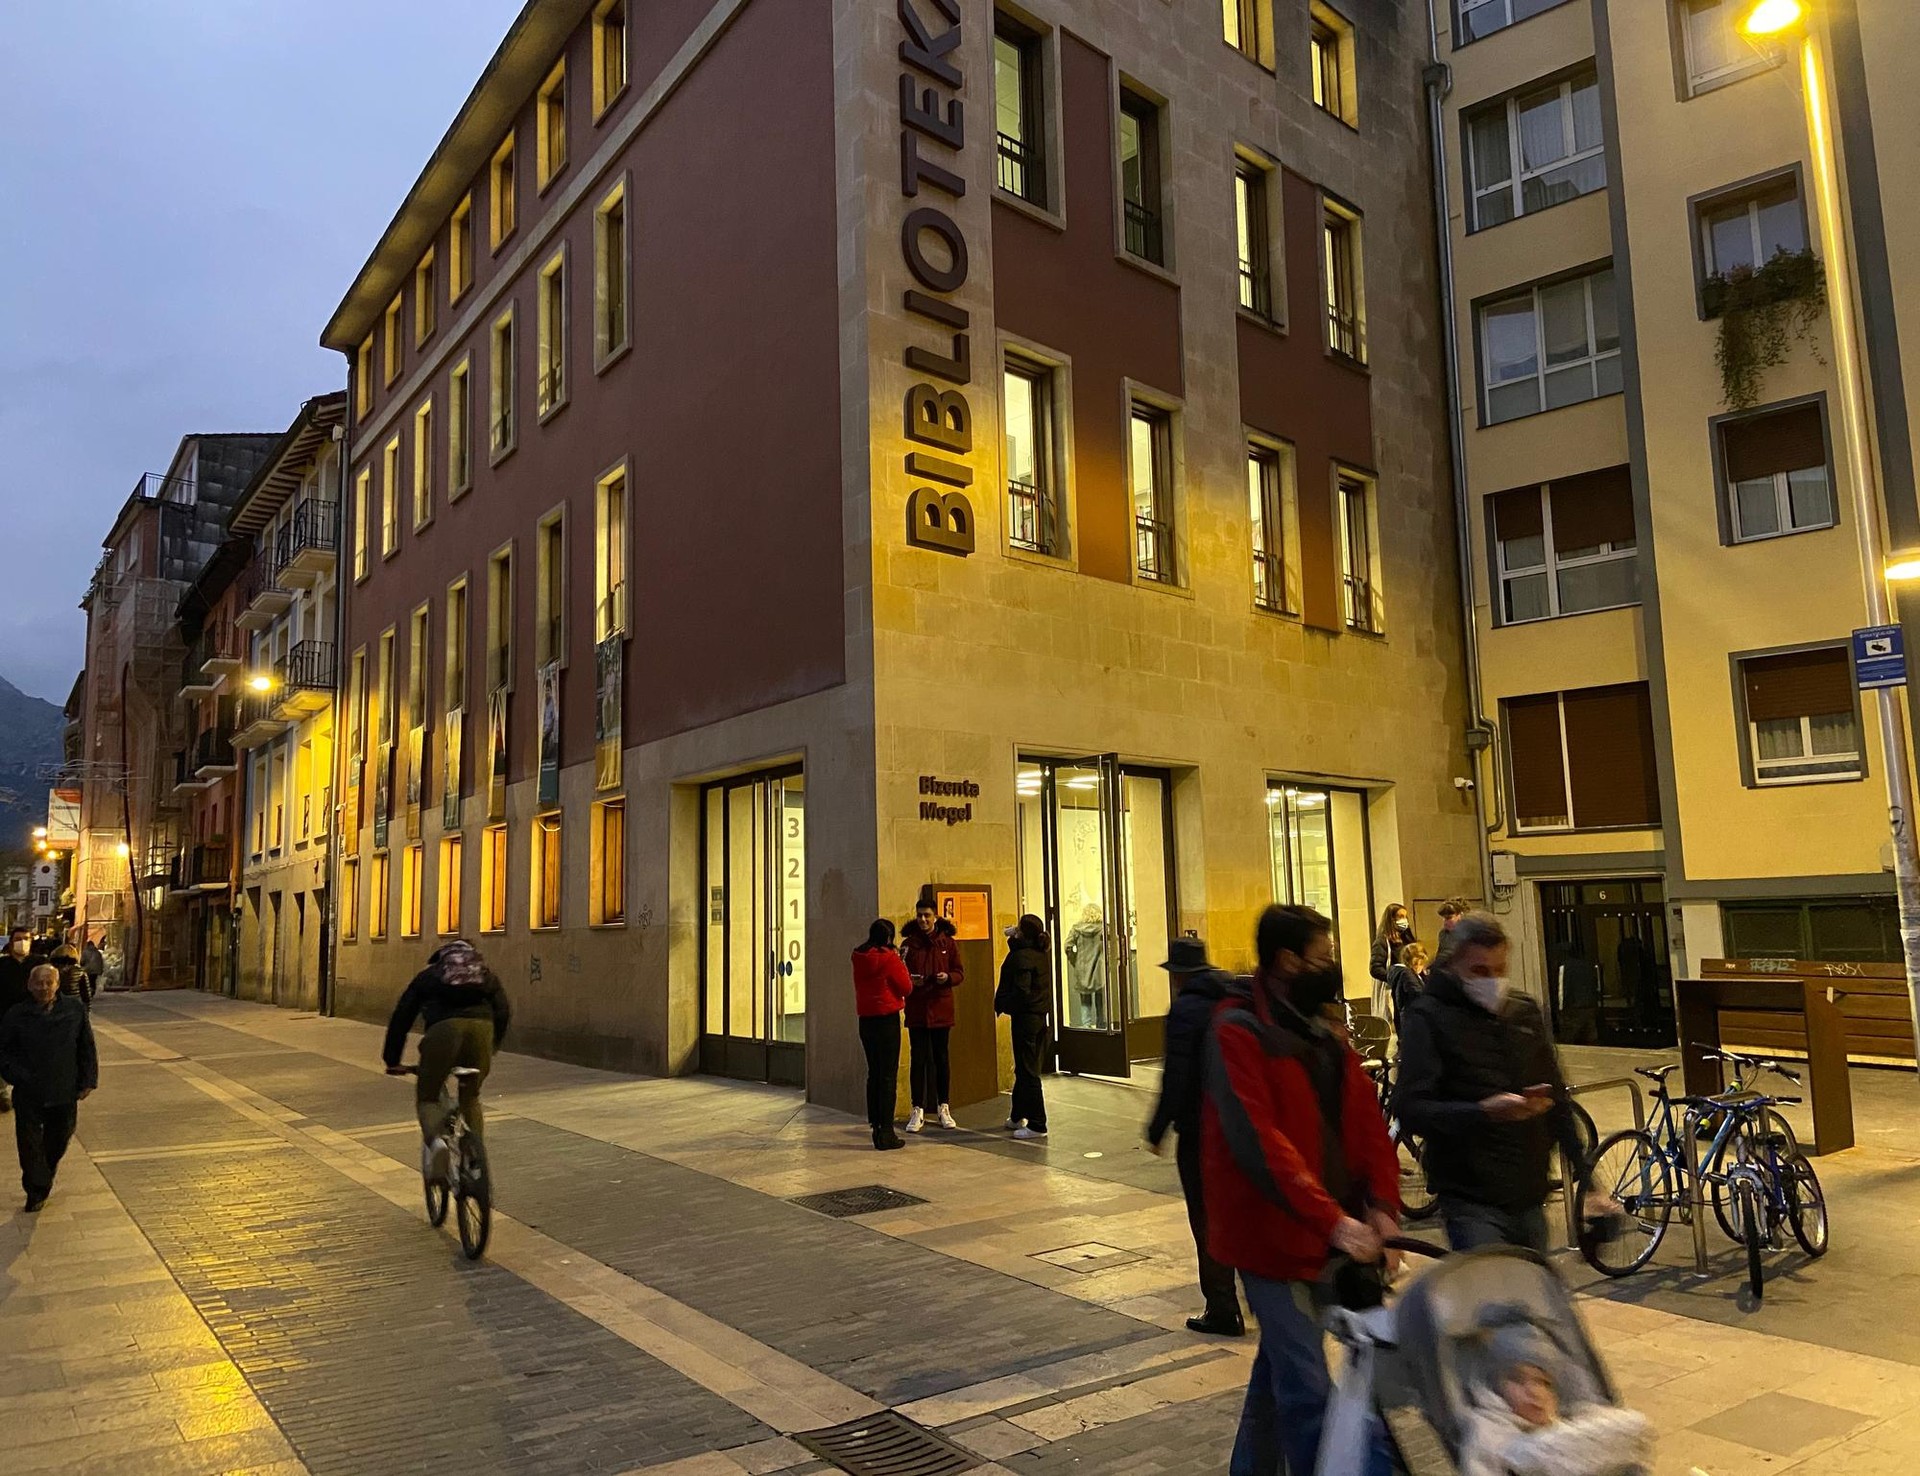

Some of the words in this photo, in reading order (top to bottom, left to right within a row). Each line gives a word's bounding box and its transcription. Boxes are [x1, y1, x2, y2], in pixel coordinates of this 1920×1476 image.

[898, 0, 975, 558] BIBLIOTEK
[920, 802, 972, 826] Mogel
[787, 817, 800, 838] 3
[788, 857, 800, 878] 2
[1599, 890, 1606, 900] 6
[789, 898, 799, 919] 1
[788, 939, 801, 961] 0
